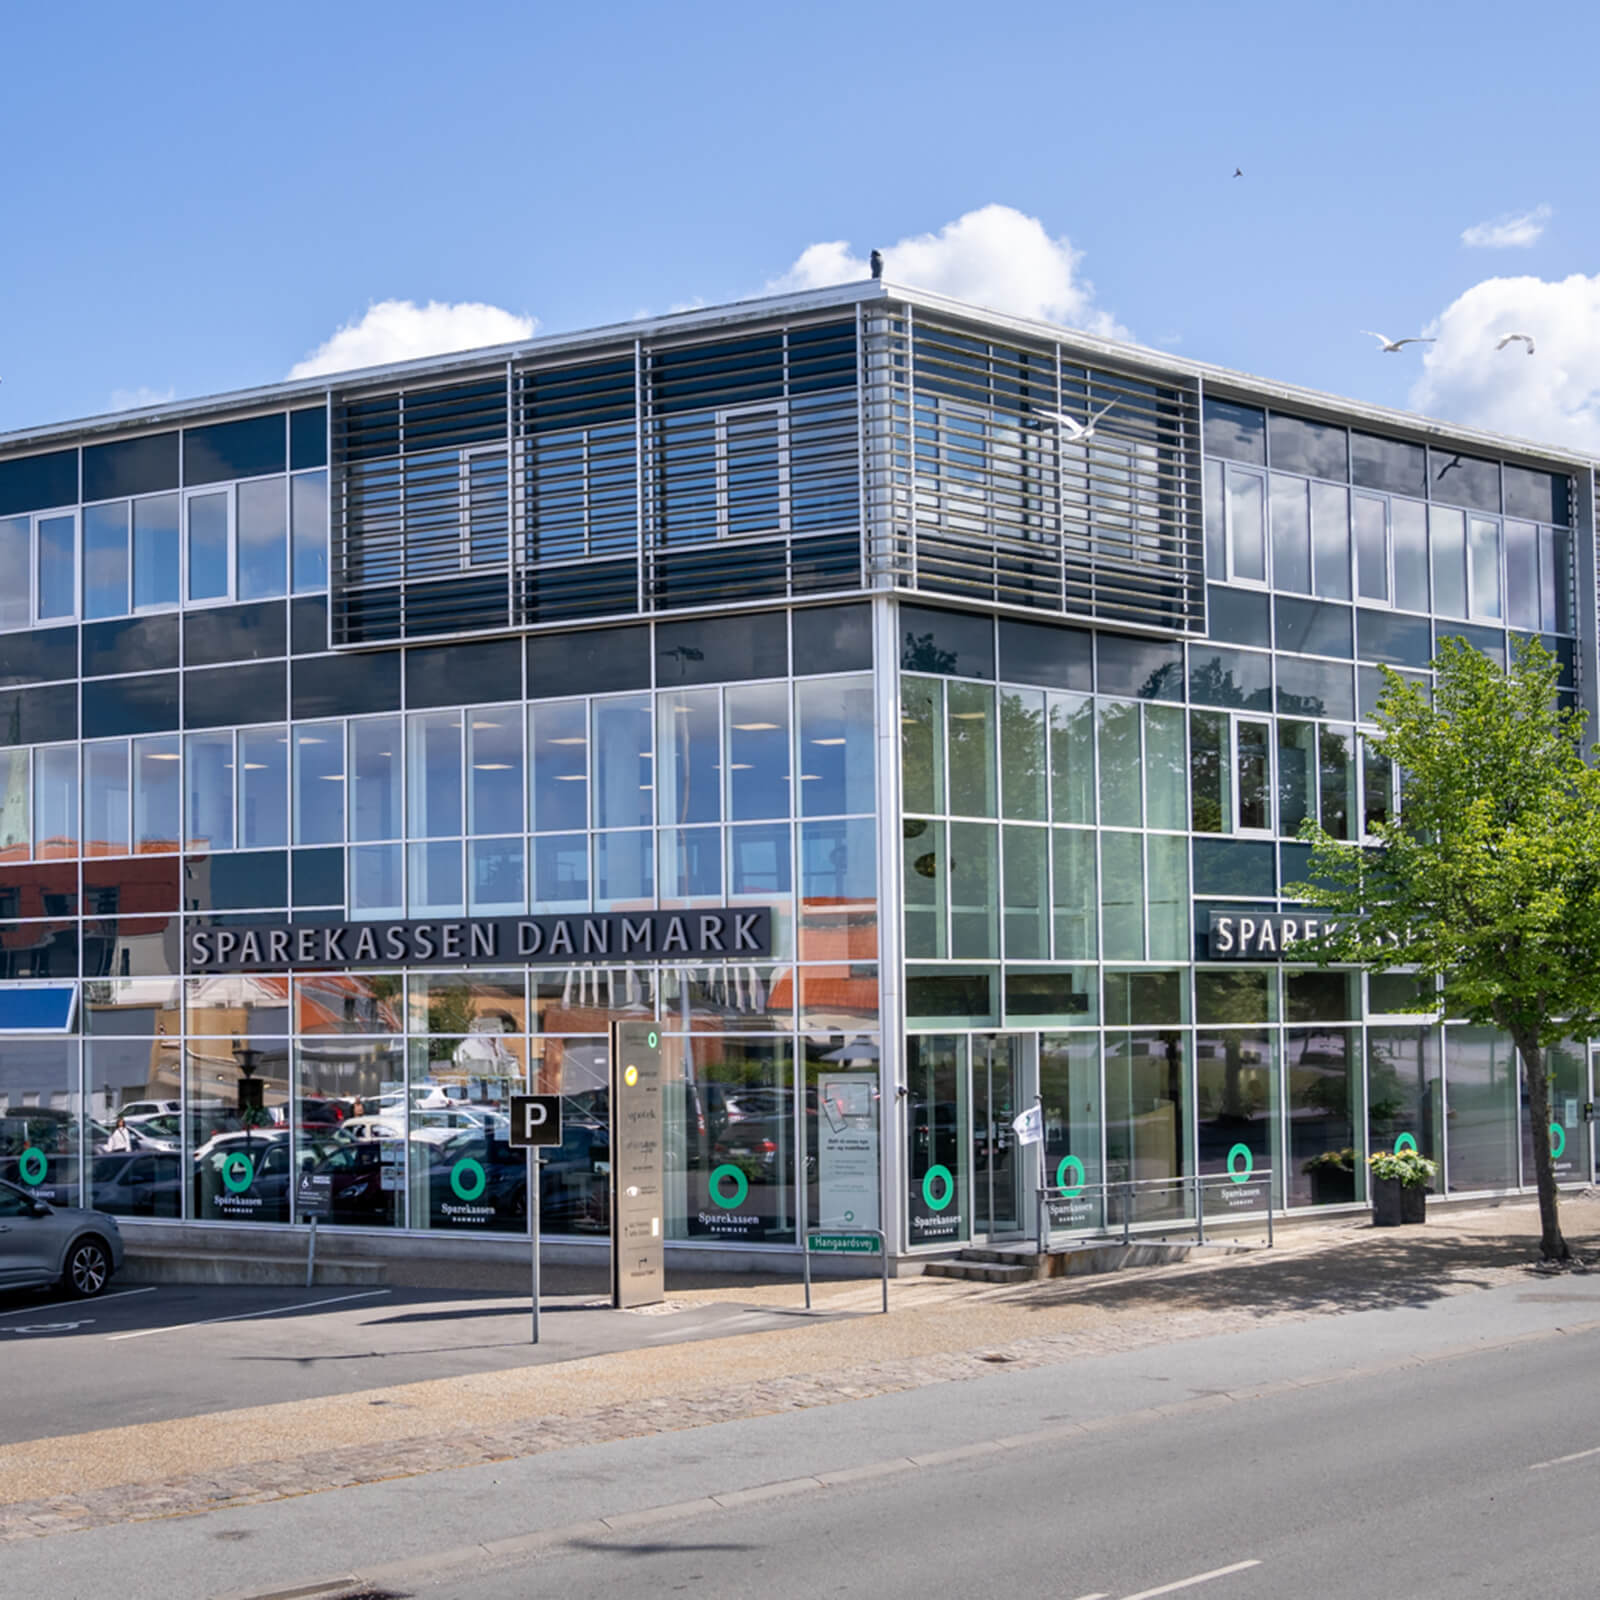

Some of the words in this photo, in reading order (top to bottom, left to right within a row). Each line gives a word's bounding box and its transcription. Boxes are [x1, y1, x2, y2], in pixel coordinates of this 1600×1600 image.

[191, 922, 495, 964] SPAREKASSEN
[517, 913, 760, 955] DANMARK
[525, 1103, 547, 1138] P
[214, 1195, 262, 1206] Sparekassen
[441, 1203, 496, 1215] Sparekassen
[698, 1212, 760, 1224] Sparekassen
[914, 1215, 962, 1229] Sparekassen
